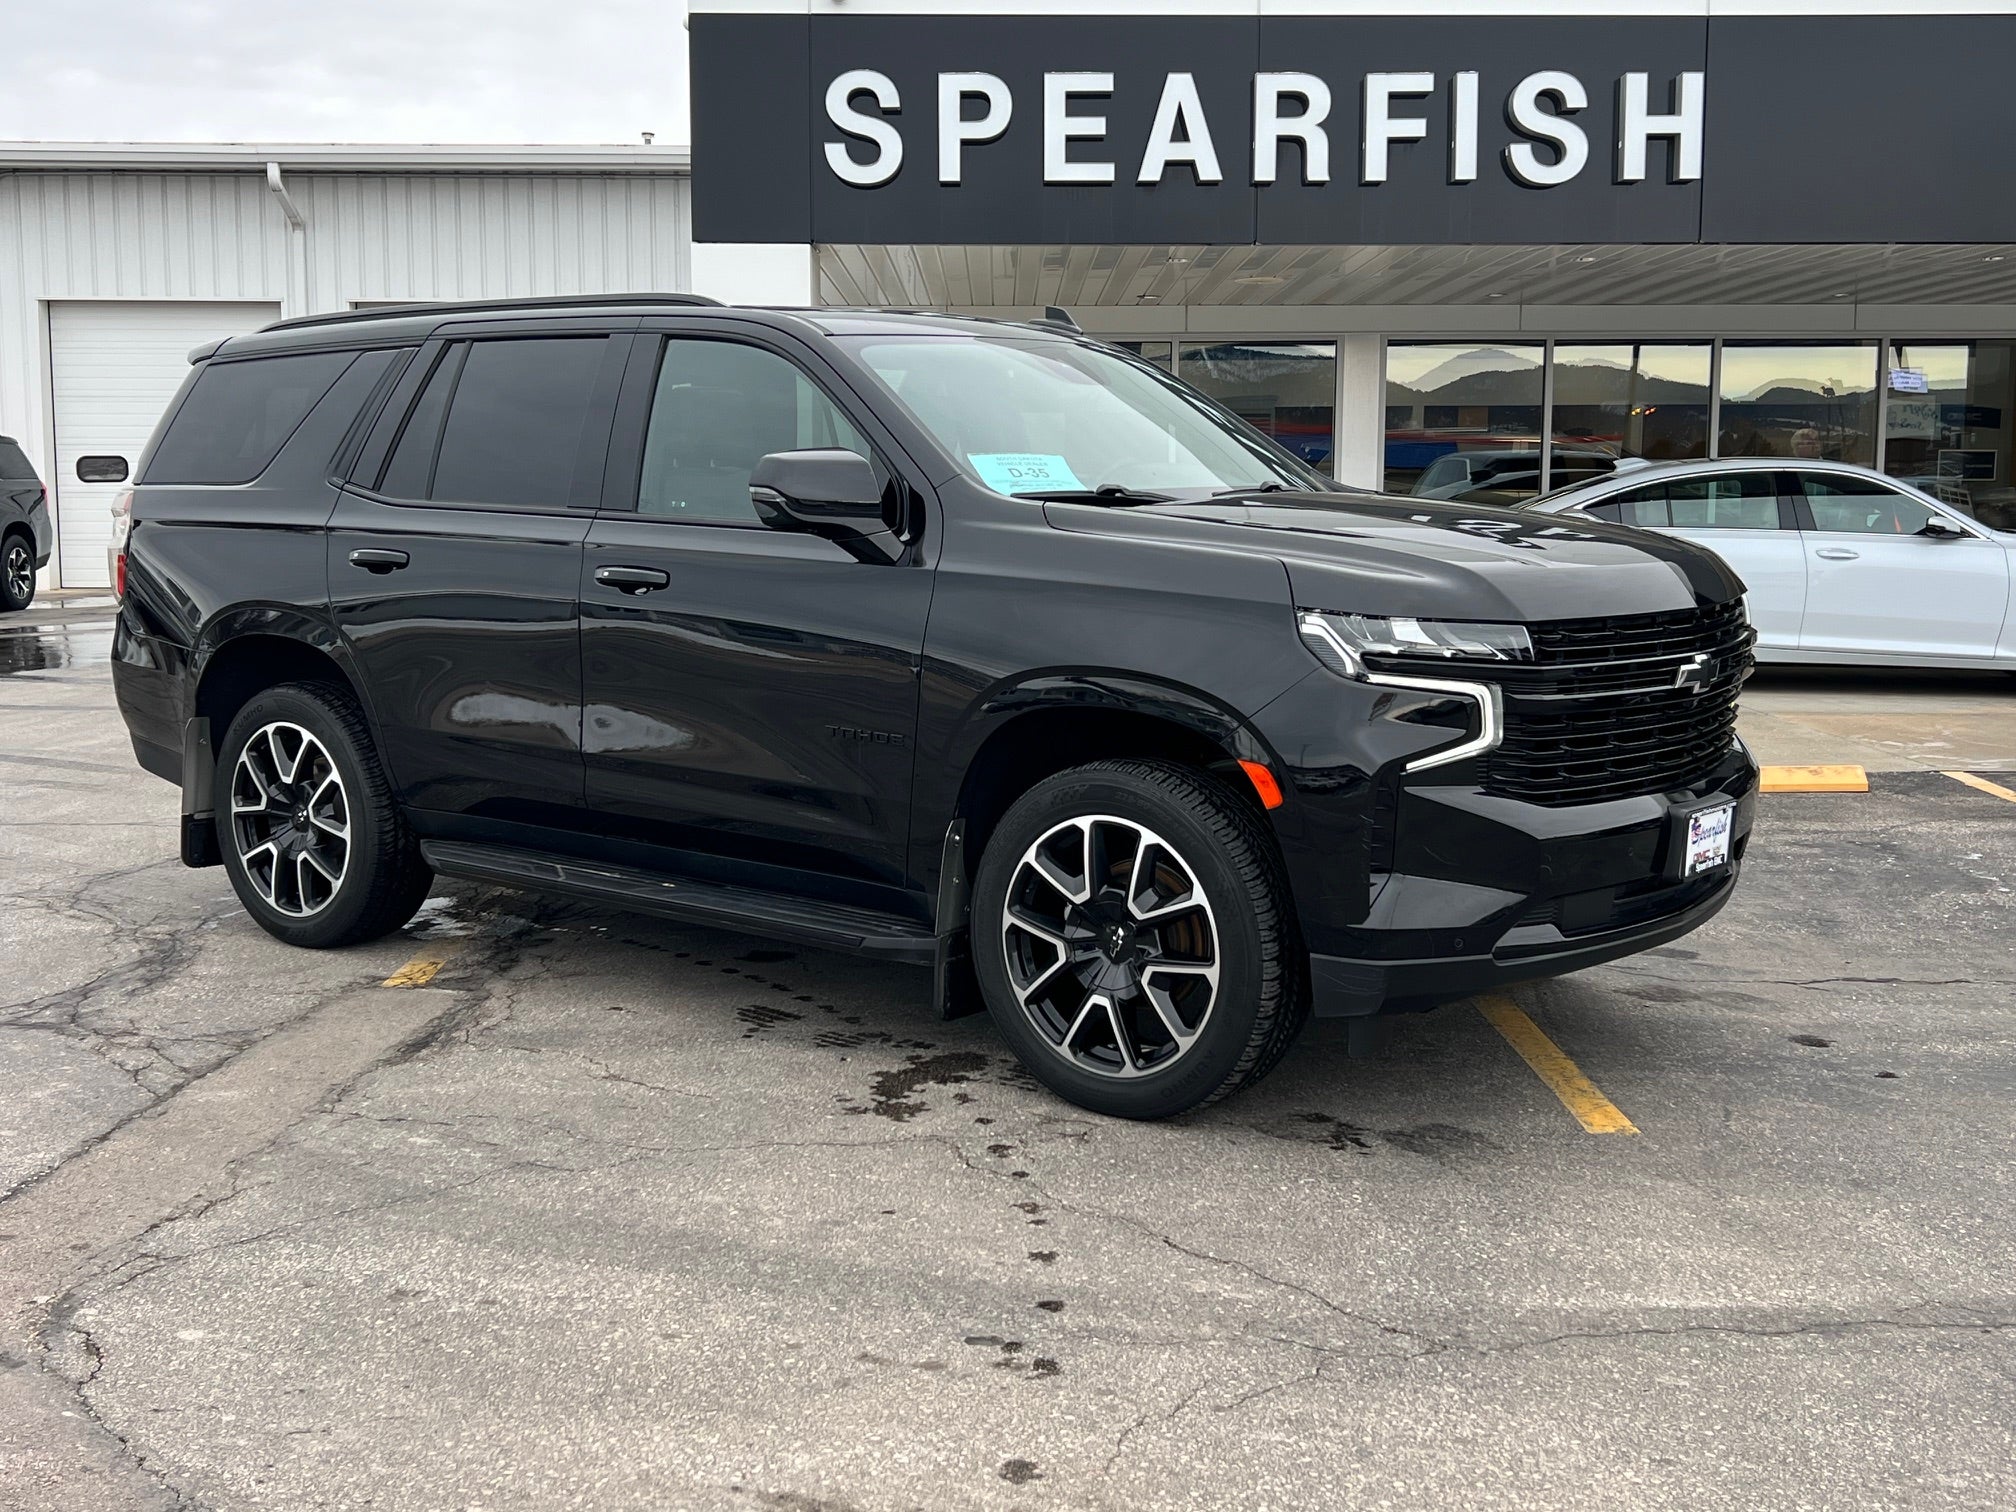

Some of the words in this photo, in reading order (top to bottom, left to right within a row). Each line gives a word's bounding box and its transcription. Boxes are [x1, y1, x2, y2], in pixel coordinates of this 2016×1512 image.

[823, 68, 1704, 188] SPEARFISH
[1008, 467, 1050, 478] D-35
[824, 724, 905, 746] TAHOE
